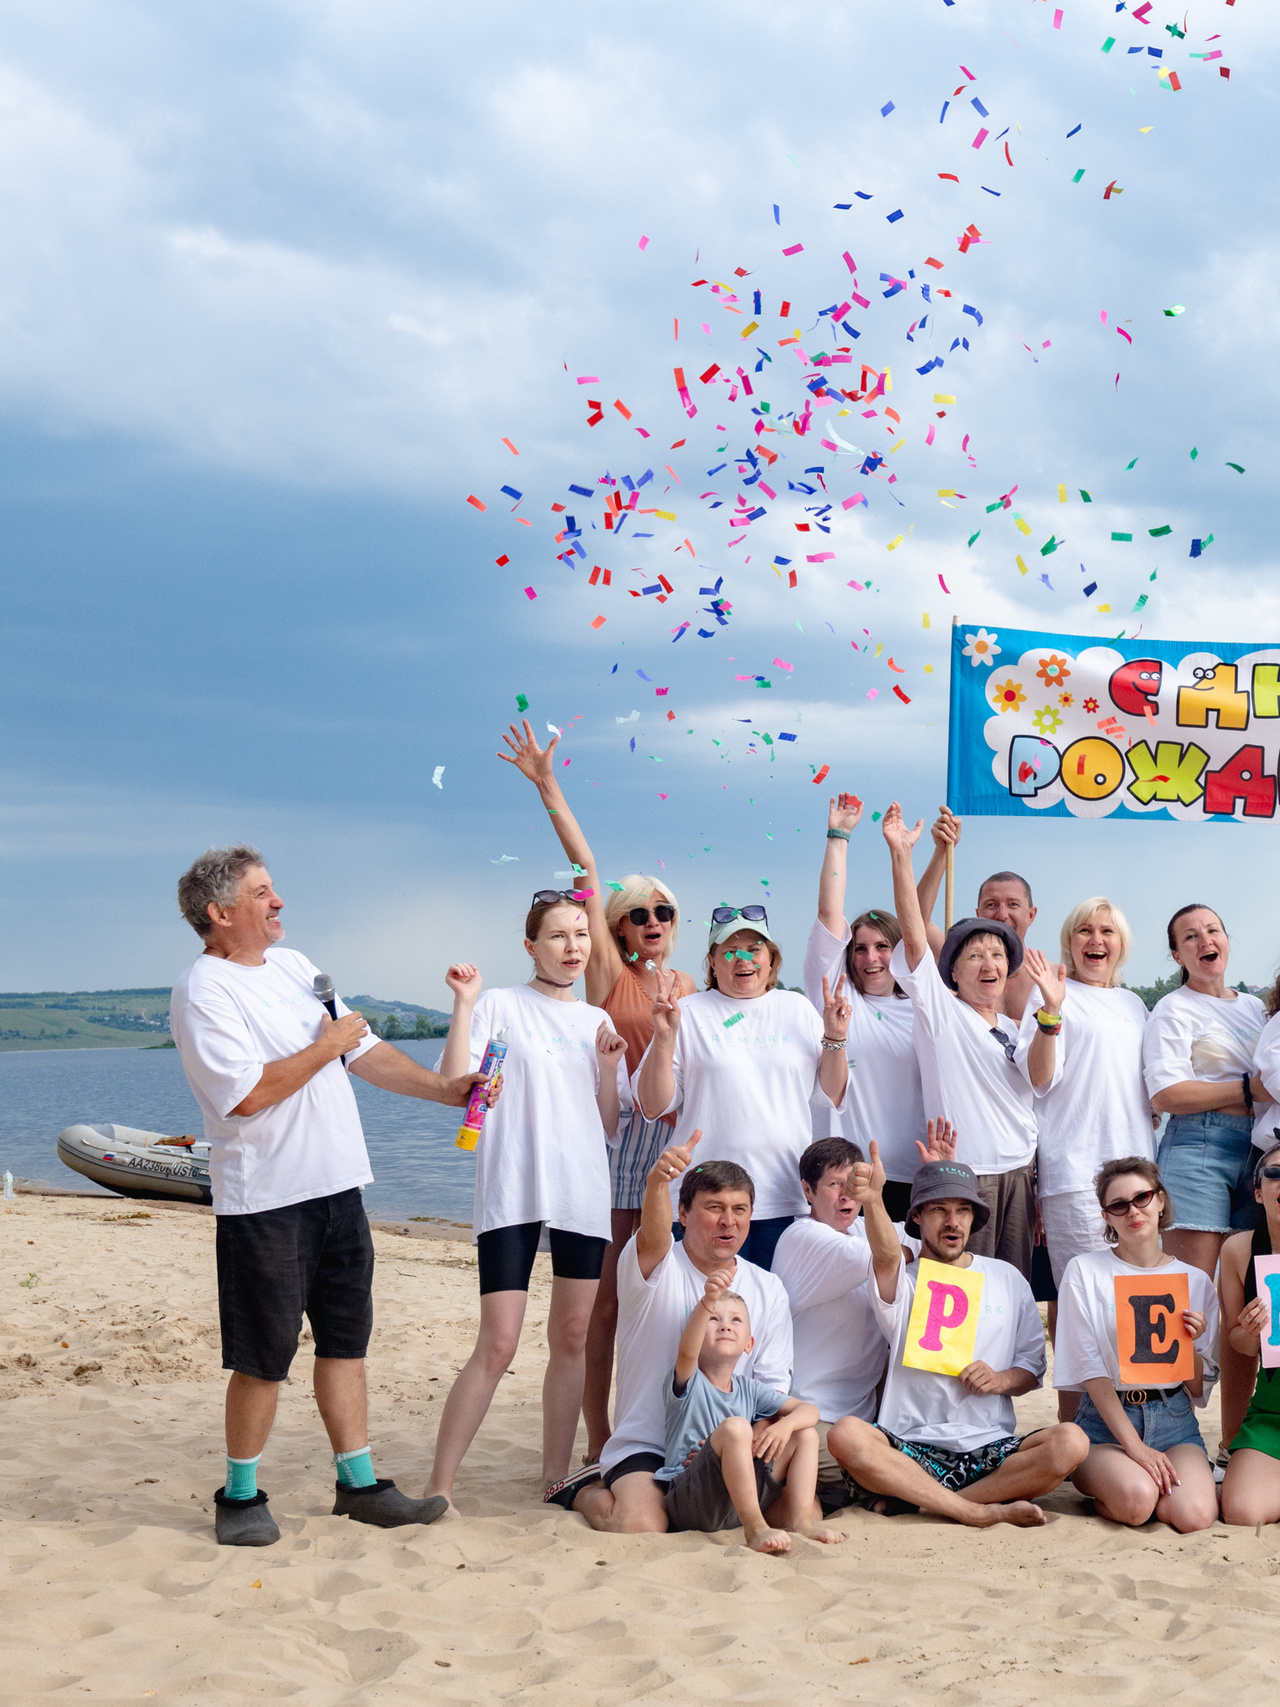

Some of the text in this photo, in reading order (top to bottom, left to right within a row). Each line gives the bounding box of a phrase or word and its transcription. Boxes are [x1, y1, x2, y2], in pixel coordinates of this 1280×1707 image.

[1108, 658, 1162, 717] С
[711, 1035, 791, 1045] REMARK
[918, 1280, 969, 1352] Р
[1128, 1294, 1181, 1364] Е
